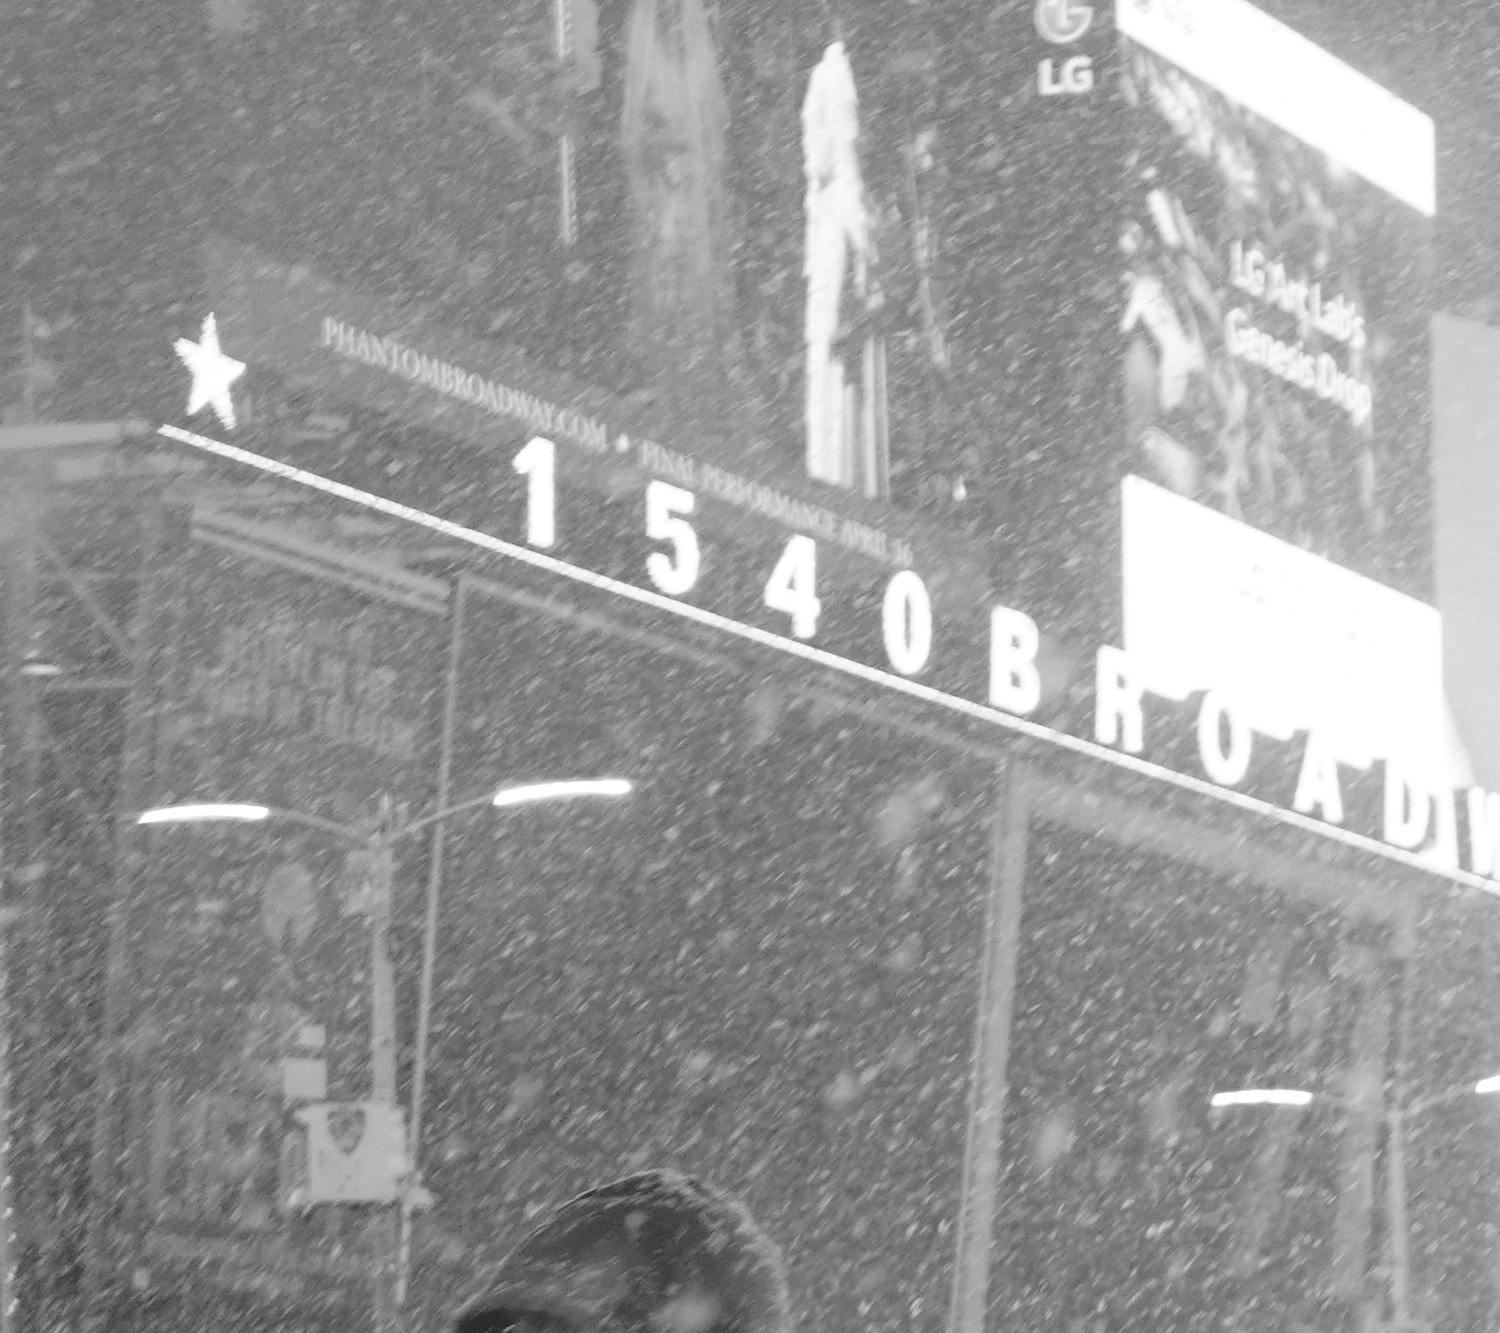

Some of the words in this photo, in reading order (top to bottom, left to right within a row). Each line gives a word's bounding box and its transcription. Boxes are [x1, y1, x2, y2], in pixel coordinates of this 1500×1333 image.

[1038, 55, 1094, 95] LG
[1229, 240, 1264, 296] LG
[1225, 307, 1315, 388] Genesis
[1316, 352, 1372, 426] Drop
[512, 436, 932, 675] 1540
